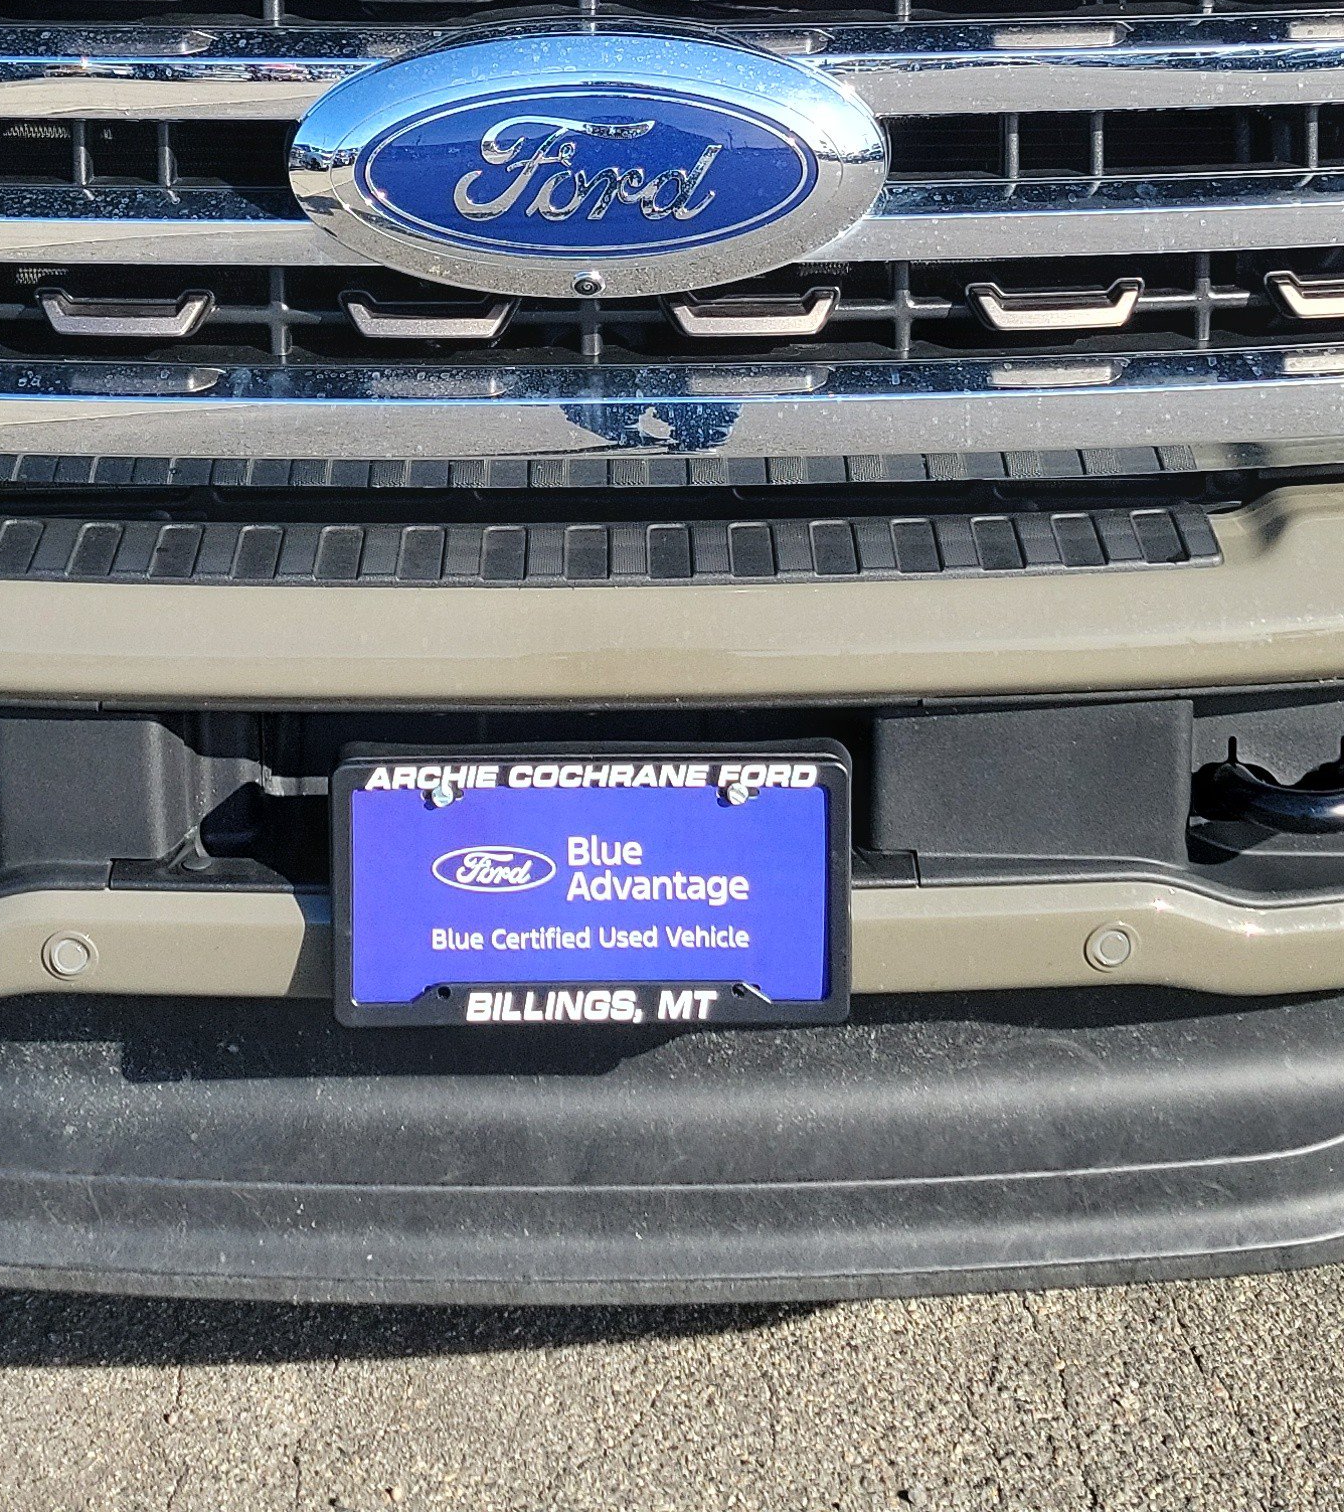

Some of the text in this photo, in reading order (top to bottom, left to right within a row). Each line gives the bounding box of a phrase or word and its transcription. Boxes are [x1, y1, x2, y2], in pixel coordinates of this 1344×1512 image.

[454, 114, 723, 221] Ford
[365, 764, 817, 790] ARCHIE COCHRANE FORD
[567, 835, 643, 866] Blue
[456, 852, 533, 884] Ford
[566, 869, 750, 906] Advantage
[431, 925, 750, 950] Blue Certified Used Vehicle
[466, 990, 717, 1023] BILLINGS, MT
